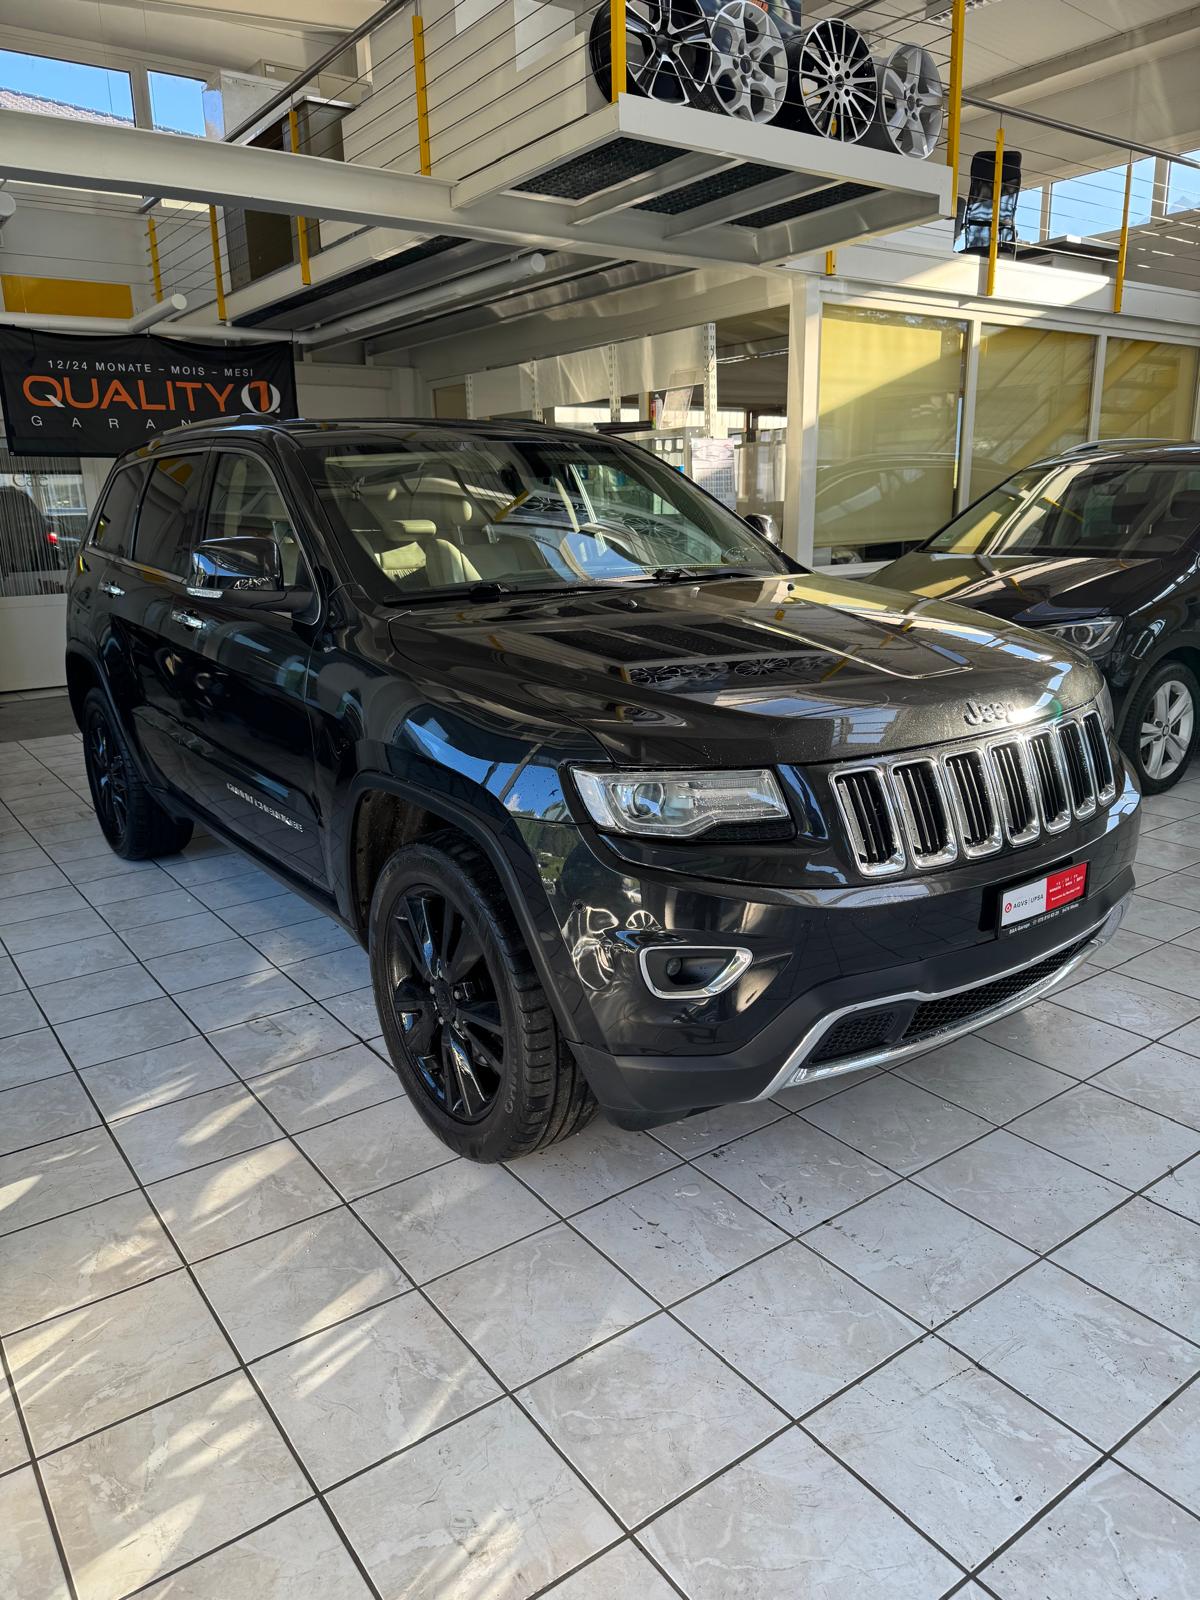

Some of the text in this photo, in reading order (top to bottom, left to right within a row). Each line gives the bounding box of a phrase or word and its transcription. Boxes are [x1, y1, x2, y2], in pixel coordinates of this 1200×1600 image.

[48, 360, 88, 371] 12/24
[95, 362, 152, 373] MONATE
[171, 366, 205, 376] MOIS
[224, 368, 254, 377] MESI
[23, 375, 235, 412] QUALITY
[964, 699, 1016, 725] Jeep
[1013, 899, 1028, 909] AGVS
